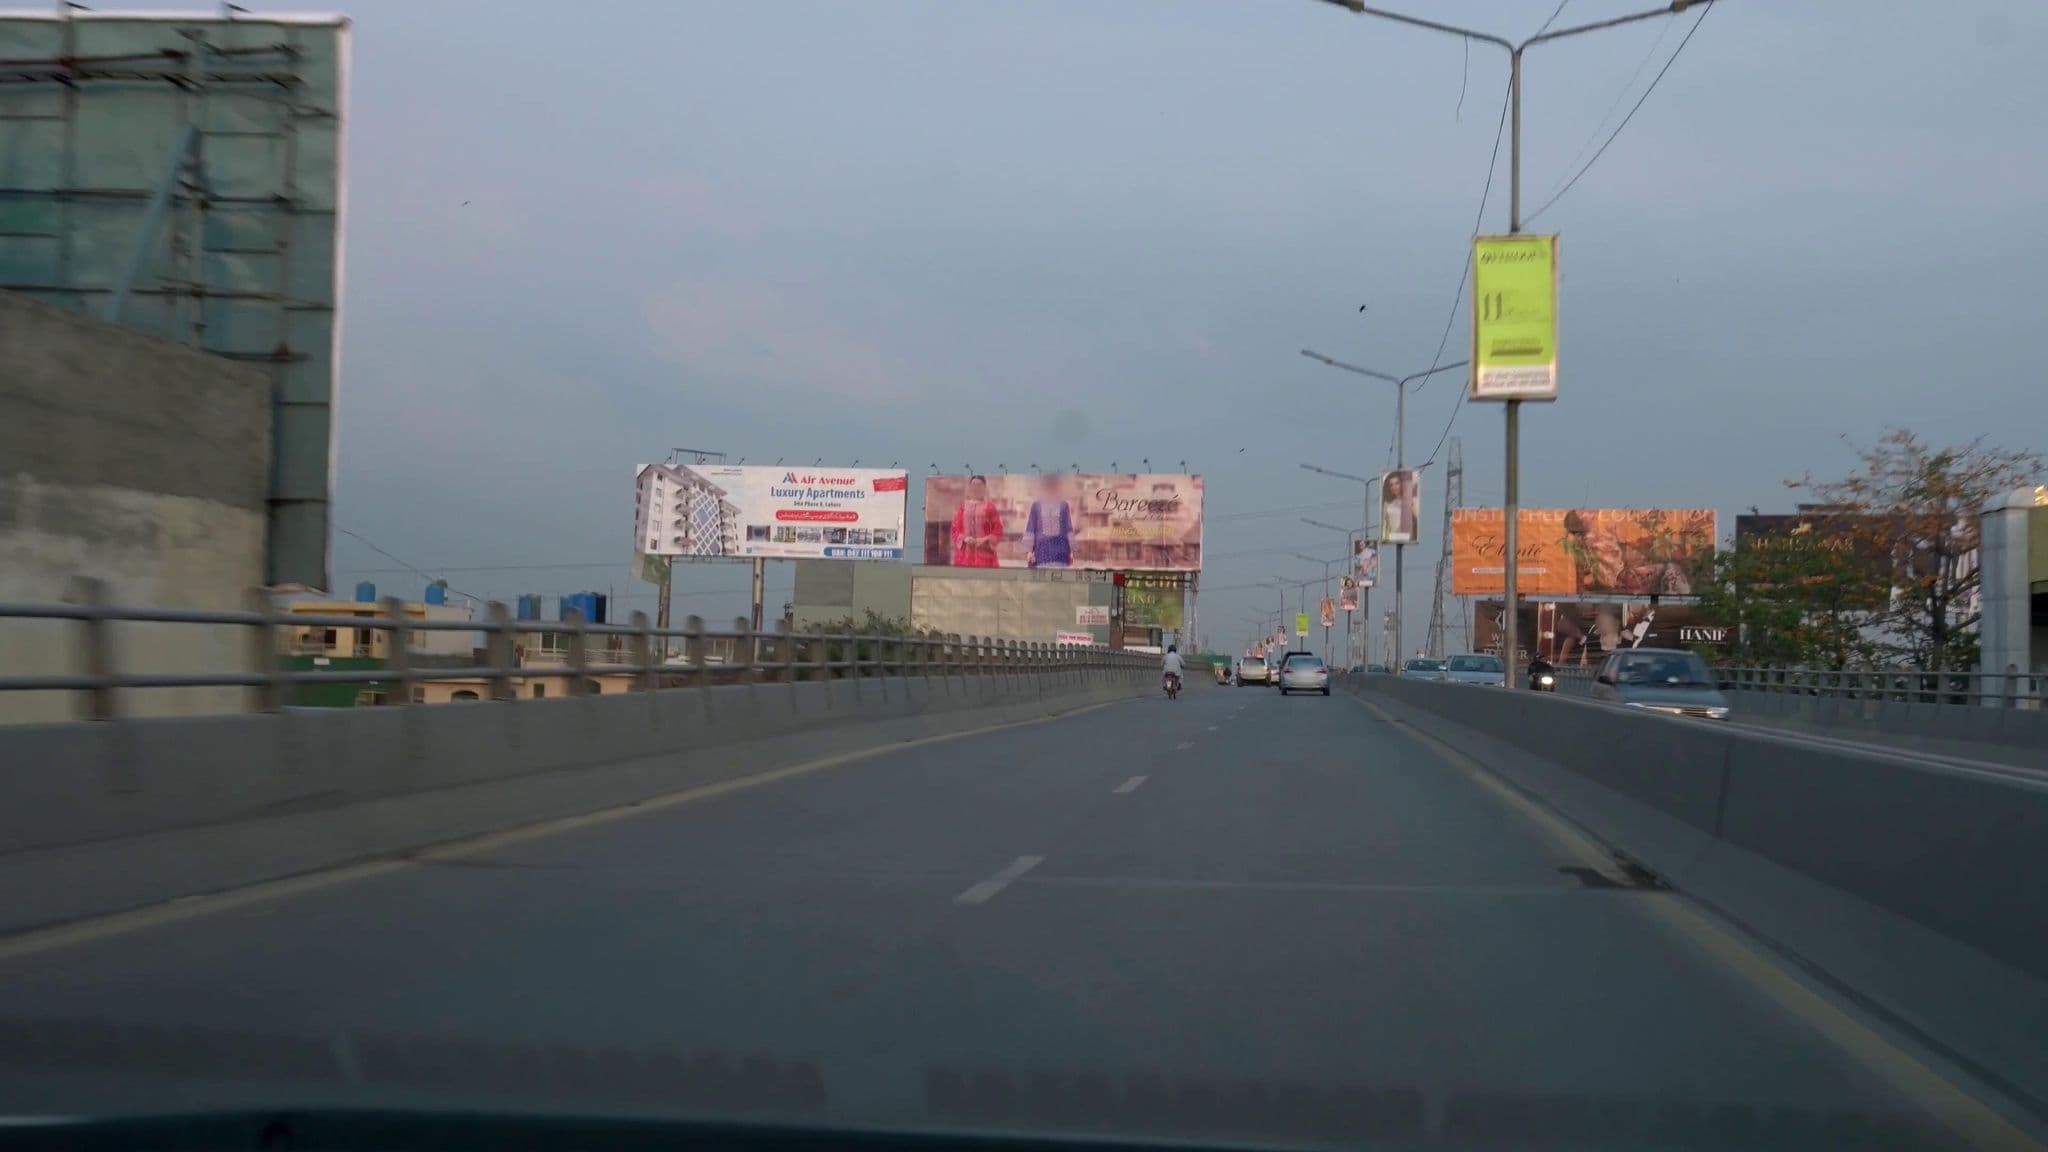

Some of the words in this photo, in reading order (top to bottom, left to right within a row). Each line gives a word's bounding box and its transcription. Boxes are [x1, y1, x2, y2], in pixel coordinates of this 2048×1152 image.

[801, 475, 816, 486] Air
[819, 476, 856, 487] Avenue
[771, 486, 807, 500] Luxury
[807, 487, 865, 500] Apartments
[1679, 629, 1728, 641] HANIF
